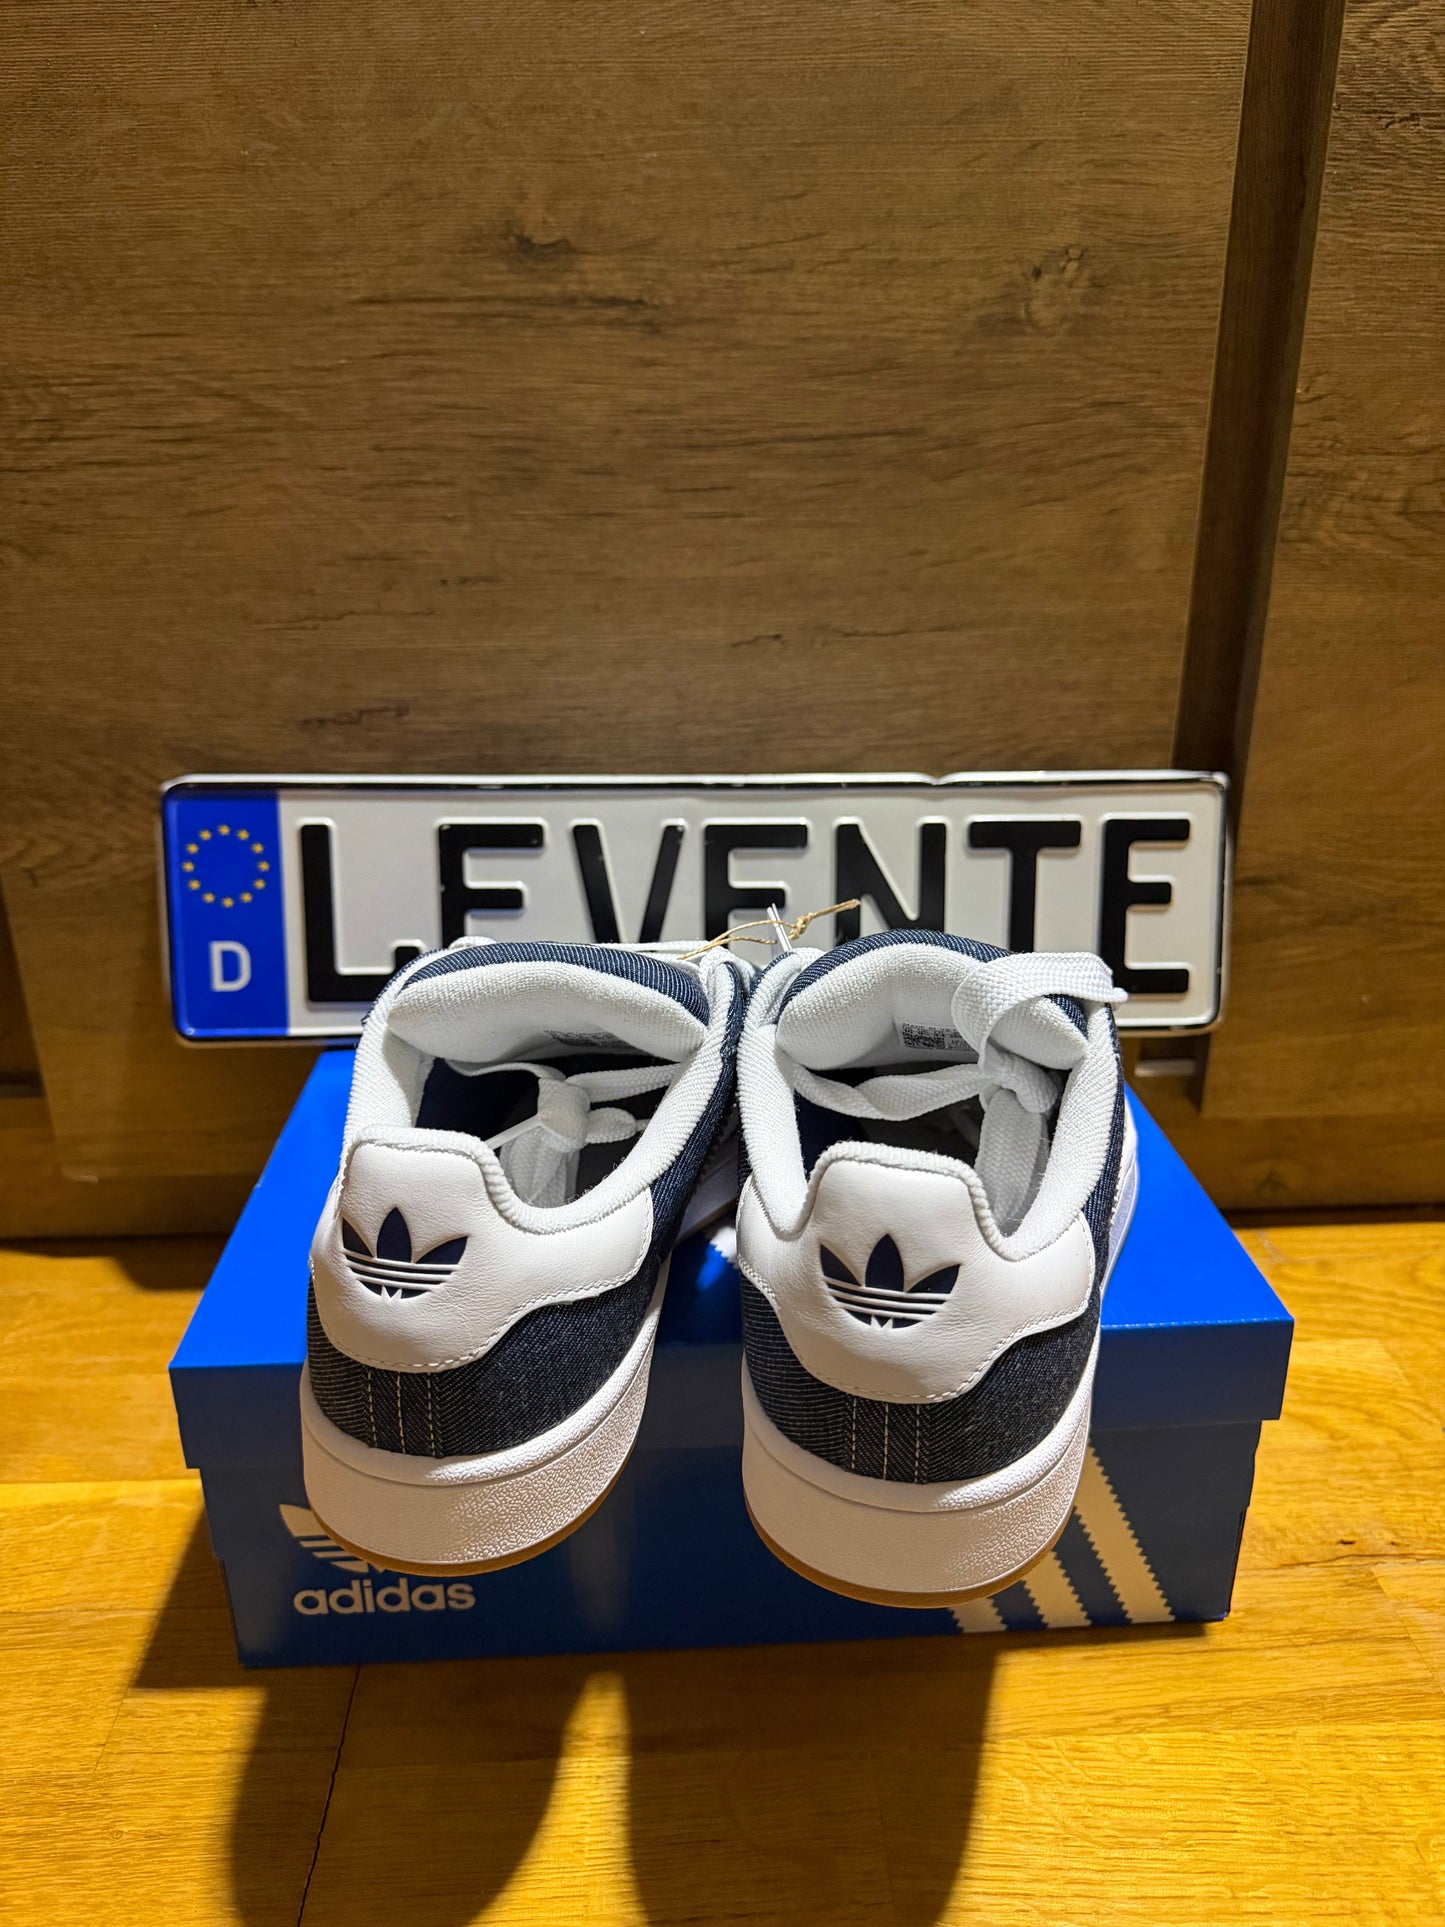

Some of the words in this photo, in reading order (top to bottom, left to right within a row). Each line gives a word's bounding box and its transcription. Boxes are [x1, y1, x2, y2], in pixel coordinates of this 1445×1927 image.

[299, 819, 1191, 1002] LEVENTE
[210, 941, 251, 992] D
[293, 1578, 476, 1615] adidas
